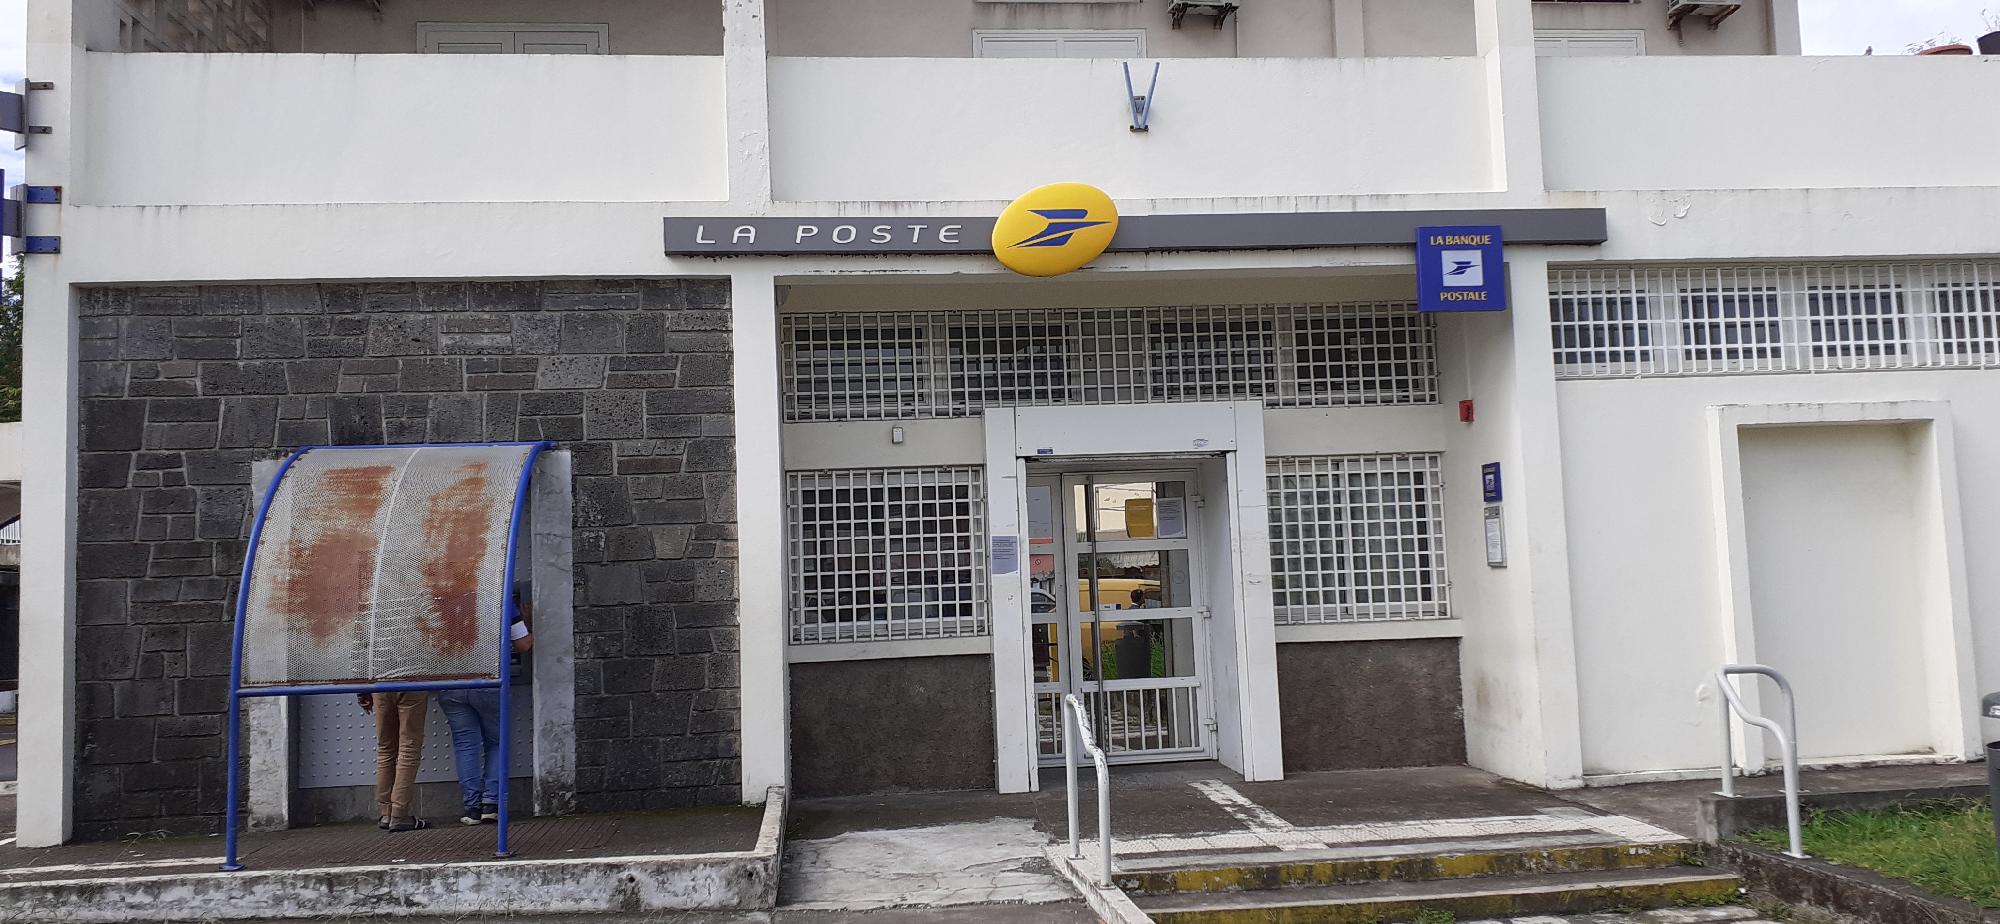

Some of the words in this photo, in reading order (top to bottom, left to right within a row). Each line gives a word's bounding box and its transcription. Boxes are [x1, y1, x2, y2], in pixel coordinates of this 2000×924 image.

[695, 225, 756, 244] LA
[795, 224, 962, 244] POSTE
[1430, 235, 1444, 245] LA
[1445, 235, 1492, 245] BANQUE
[1440, 291, 1488, 301] POSTALE
